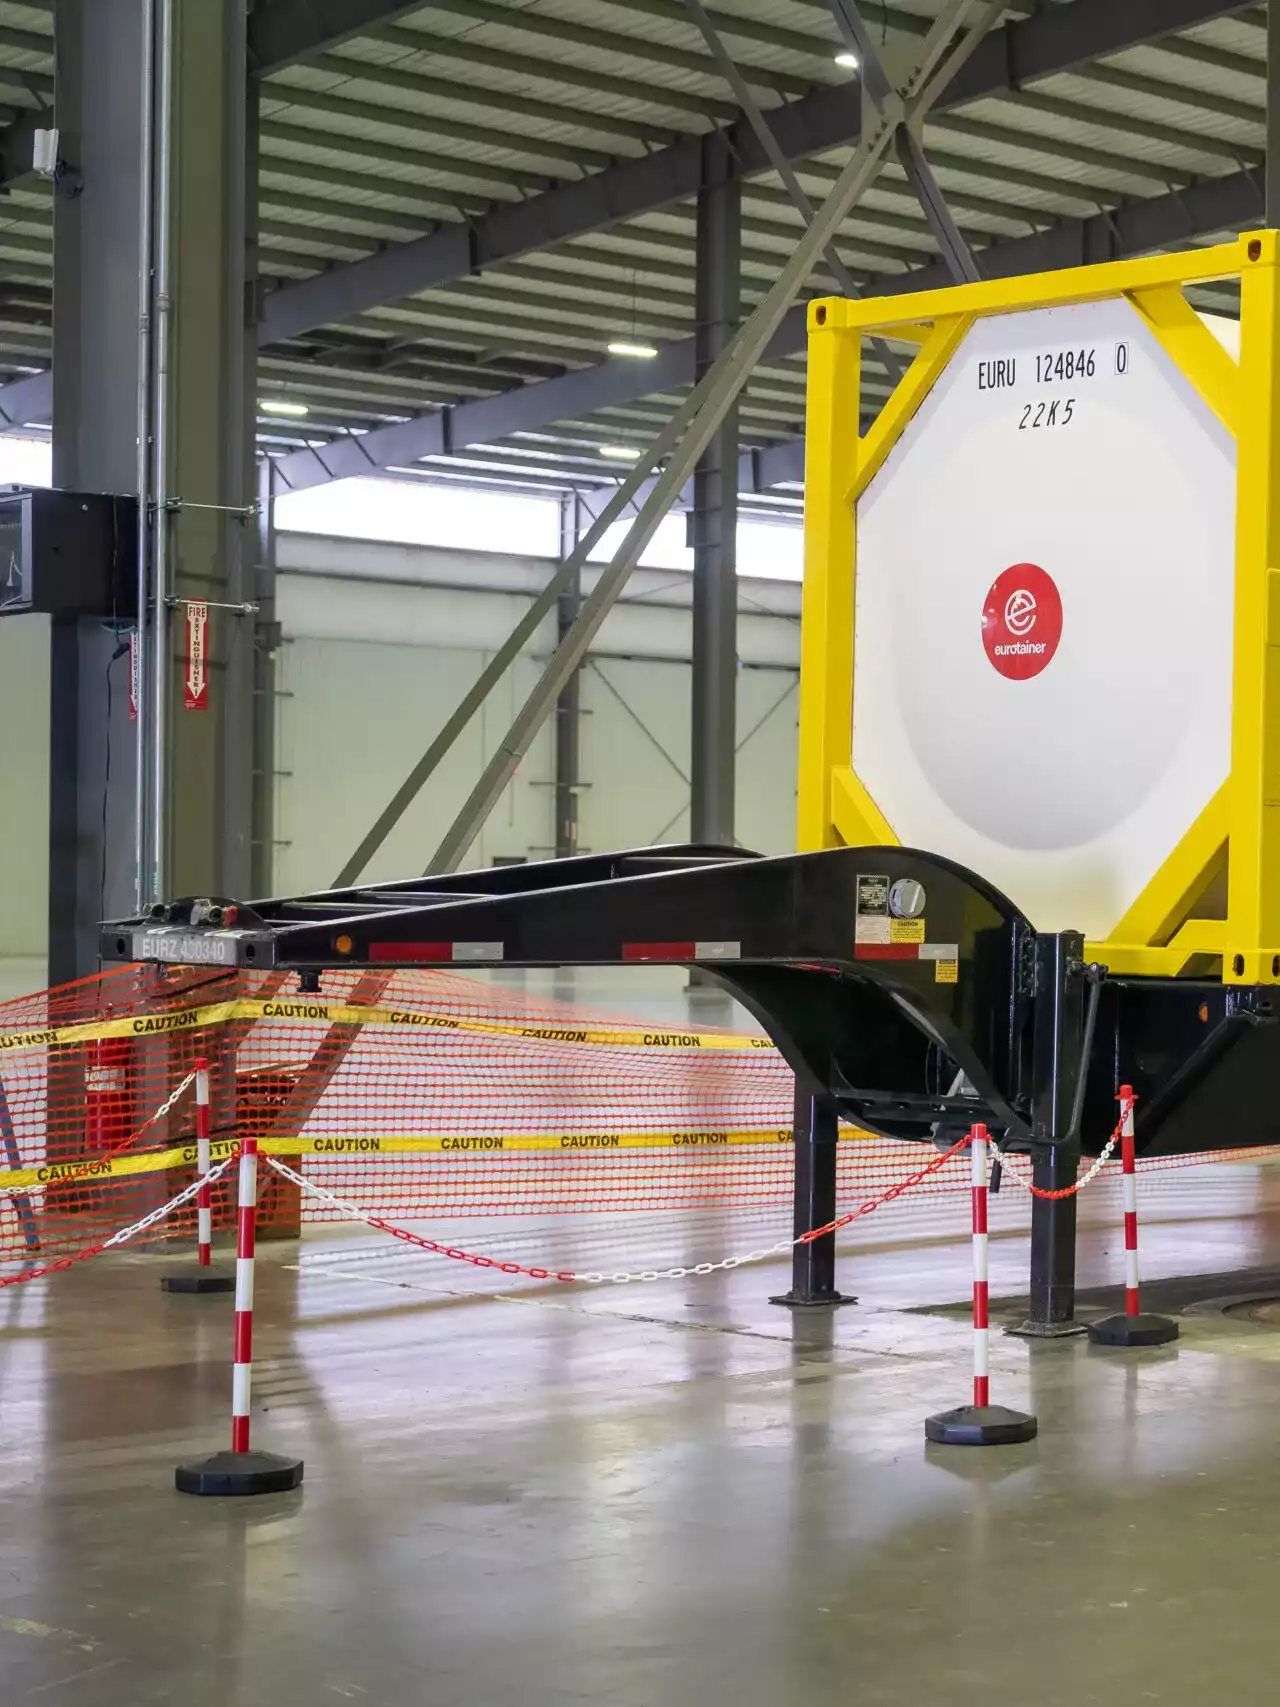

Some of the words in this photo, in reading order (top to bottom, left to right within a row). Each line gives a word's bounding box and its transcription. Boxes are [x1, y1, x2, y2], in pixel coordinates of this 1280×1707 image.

[978, 358, 1016, 390] EURU
[1035, 349, 1096, 383] 124846
[1117, 344, 1127, 373] 0
[1018, 399, 1076, 430] 22K5
[188, 607, 206, 618] FIRE
[193, 618, 201, 687] EXTINGUISHER
[994, 640, 1047, 656] eurotainer
[142, 938, 178, 957] EURZ
[0, 1031, 58, 1048] UTION
[133, 1010, 198, 1033] CAUTION
[263, 1003, 329, 1019] CAUTION
[390, 1012, 460, 1028] CAUTION
[522, 1028, 587, 1043] CAUTION
[643, 1034, 701, 1047] CAUTION
[314, 1138, 380, 1151] CAUTION
[441, 1137, 504, 1150] CAUTION
[560, 1134, 620, 1148] CAUTION
[673, 1132, 728, 1145] CAUTION
